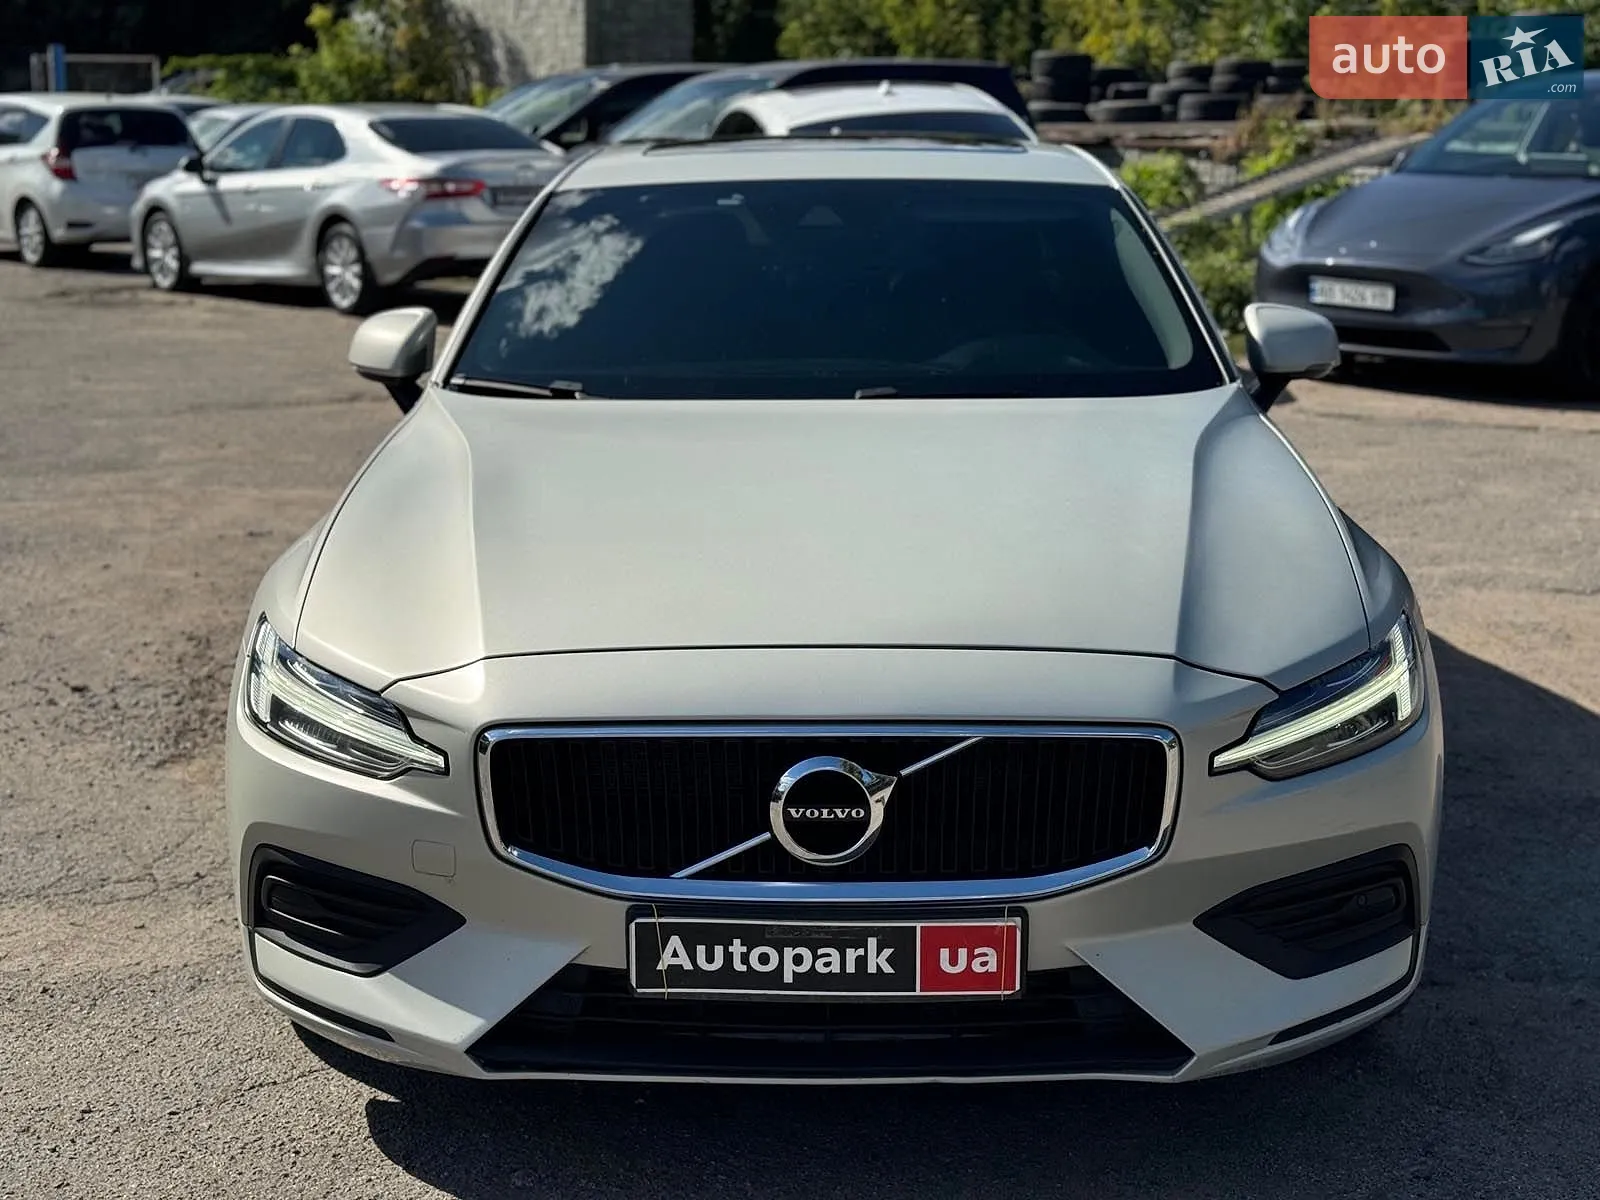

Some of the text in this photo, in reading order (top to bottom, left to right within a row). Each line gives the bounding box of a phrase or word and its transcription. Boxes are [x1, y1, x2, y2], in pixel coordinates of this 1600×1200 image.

[786, 807, 866, 819] VOLVO
[655, 934, 998, 984] Autopark ua
